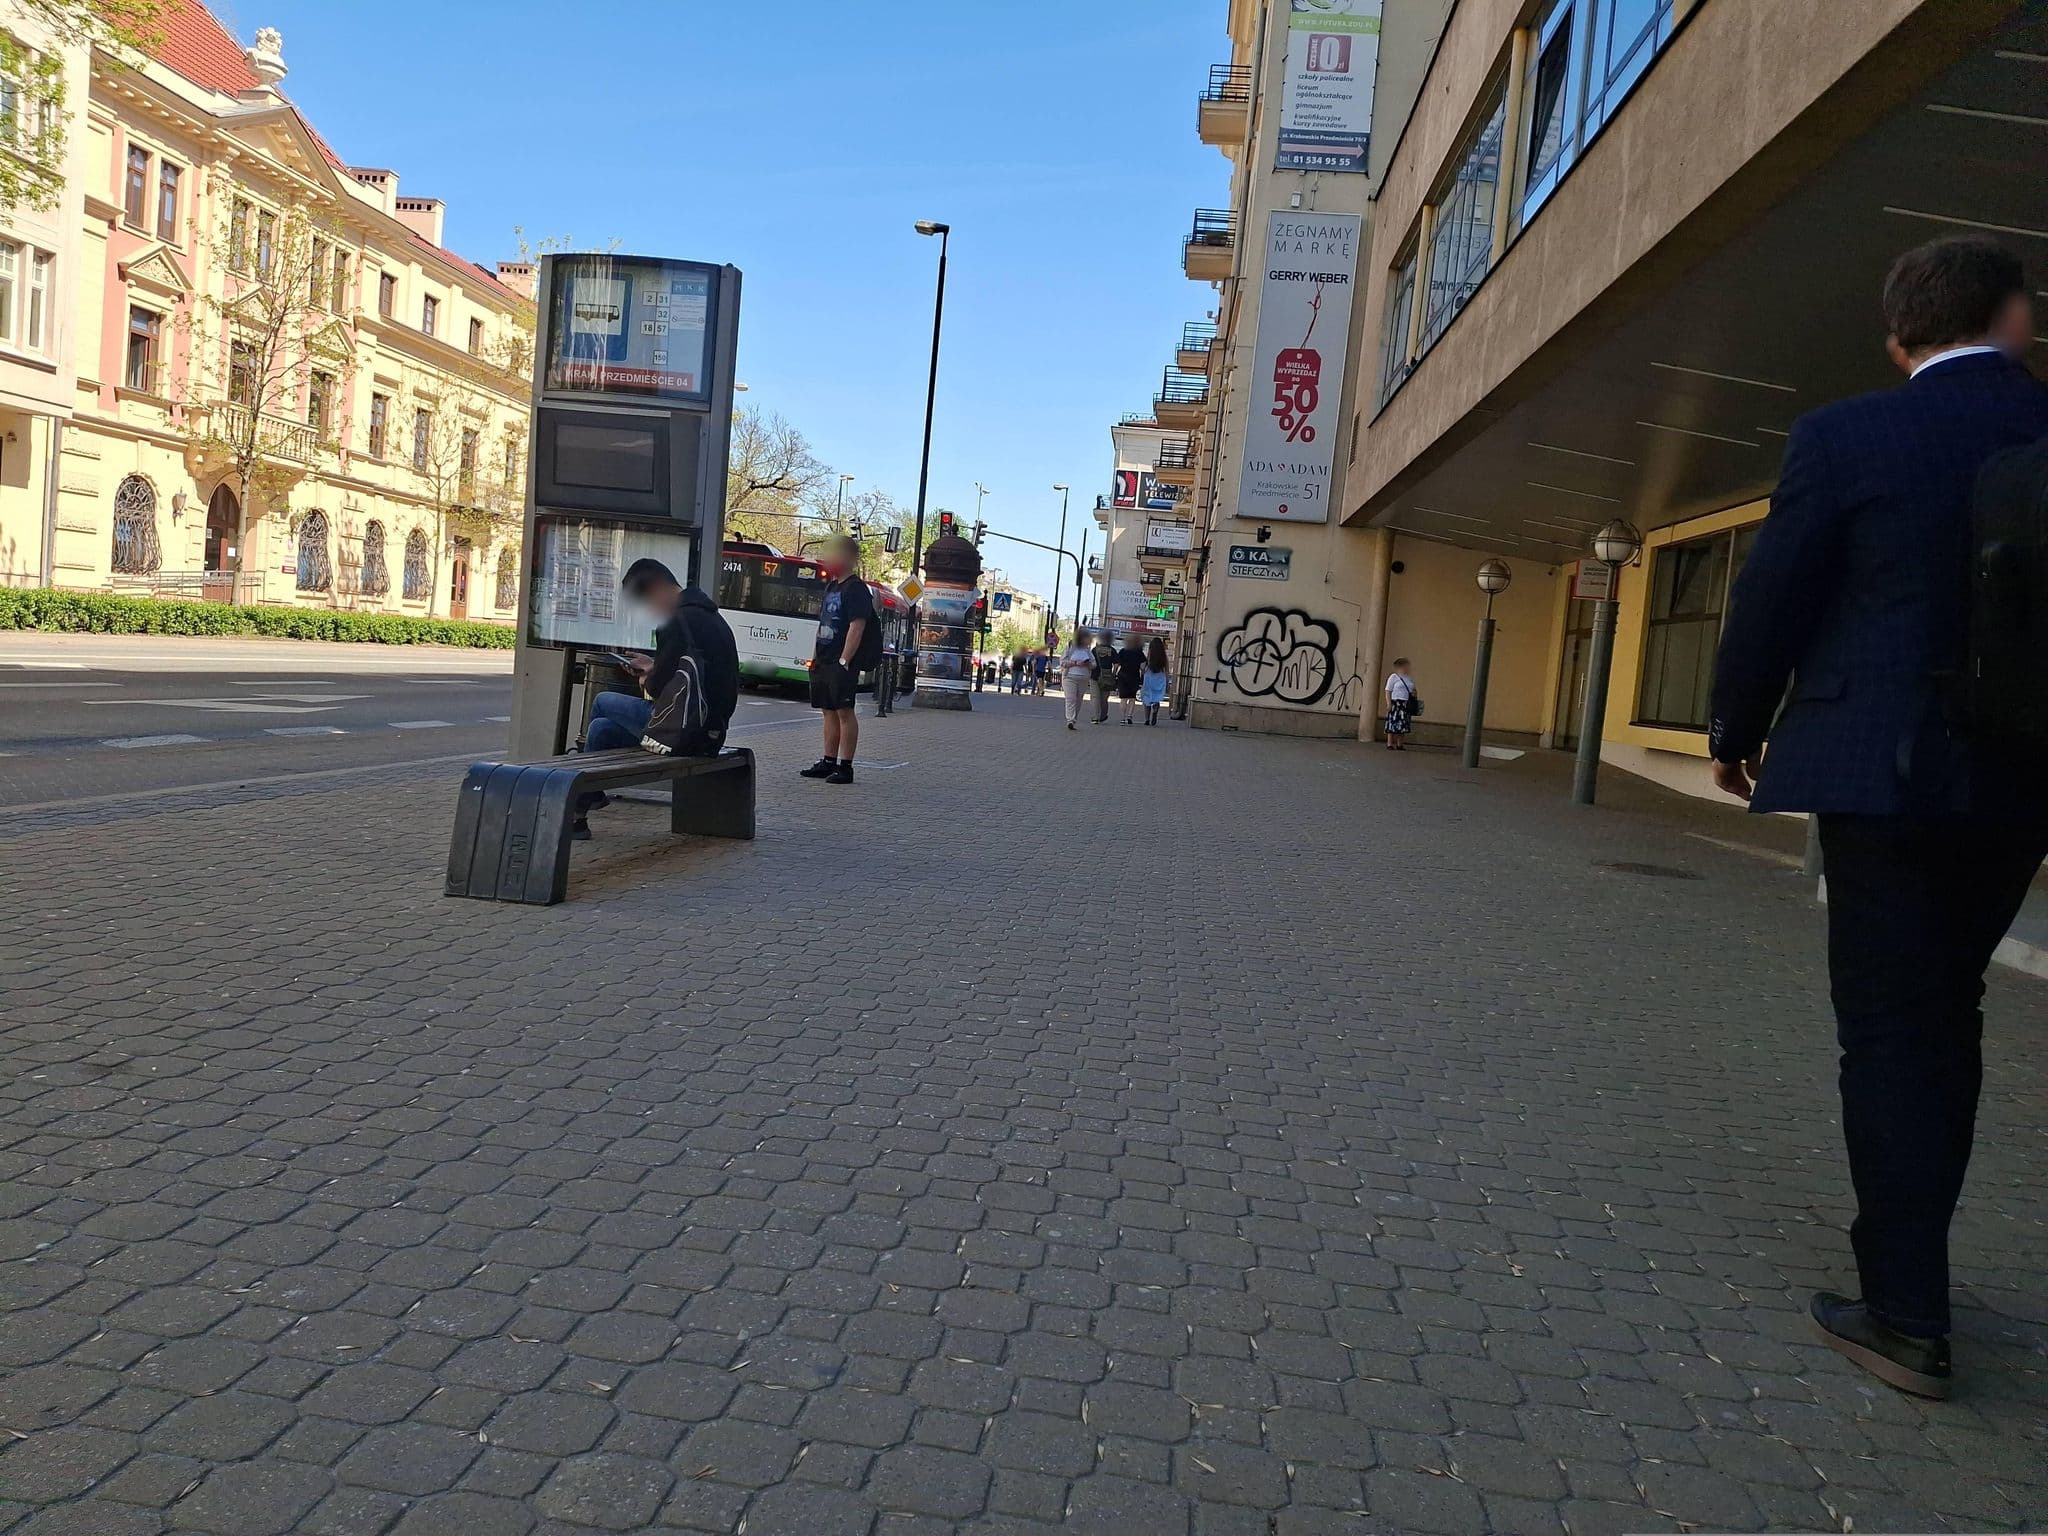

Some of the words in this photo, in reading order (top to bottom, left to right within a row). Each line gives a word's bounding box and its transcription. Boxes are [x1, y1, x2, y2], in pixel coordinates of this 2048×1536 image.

[1298, 74, 1319, 82] szkoły
[1295, 91, 1353, 101] ogólnokształcące
[1295, 102, 1333, 111] gimnazjum
[1293, 155, 1303, 163] 81
[1305, 156, 1322, 164] 534
[1325, 157, 1337, 165] 95
[1339, 158, 1351, 166] 55
[1275, 222, 1353, 240] ŻEGNAMY
[1274, 241, 1350, 259] MARKĘ
[1269, 270, 1307, 282] GERRY
[1309, 273, 1348, 284] WEBER
[647, 295, 653, 303] 2
[657, 310, 668, 318] 32
[656, 324, 667, 333] 57
[1286, 361, 1310, 370] WIELKA
[1277, 367, 1317, 377] WYPRZEDAŻ
[600, 371, 674, 386] PRZEDMIEŚCIE
[676, 377, 688, 386] 04
[1271, 382, 1319, 416] 50
[1256, 480, 1299, 490] Krakowskie
[1251, 488, 1300, 499] Przedmieście
[1303, 482, 1320, 500] 51
[723, 561, 742, 573] 2474
[764, 561, 778, 576] 57
[1113, 620, 1132, 629] BAR
